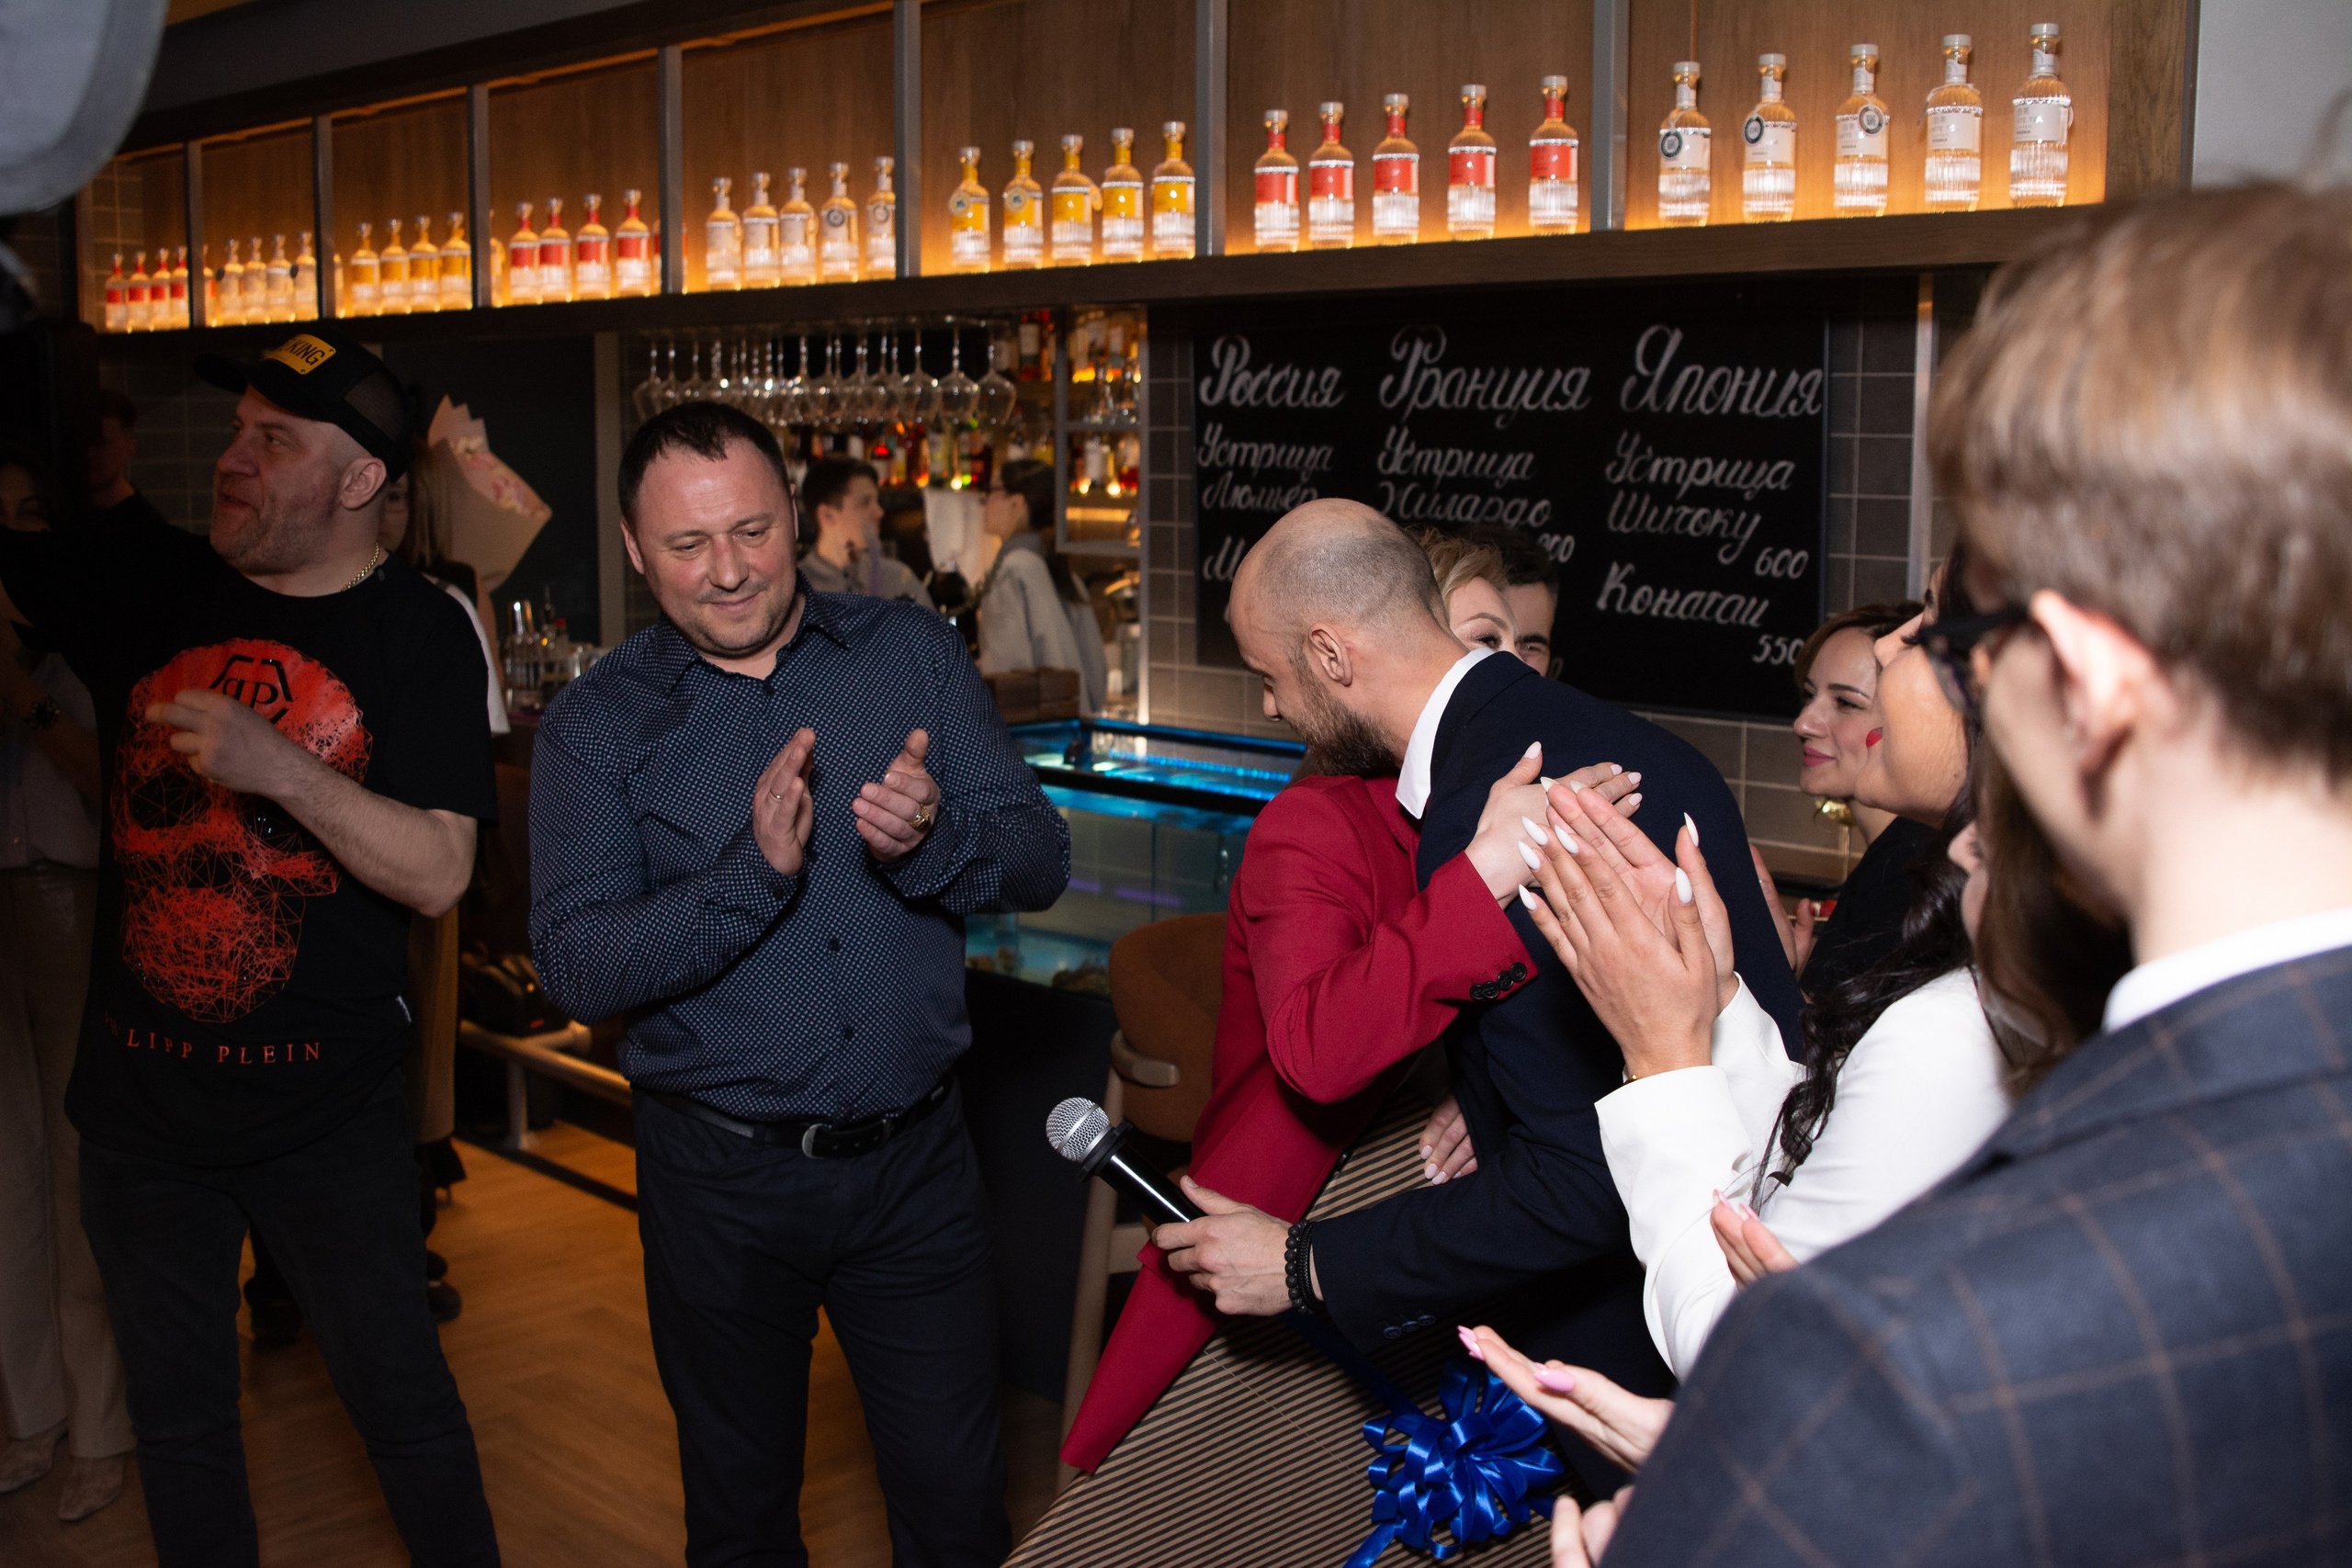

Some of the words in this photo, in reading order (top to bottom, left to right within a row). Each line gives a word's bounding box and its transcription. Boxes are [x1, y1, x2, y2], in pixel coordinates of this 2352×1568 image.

[1199, 334, 1347, 407] Россия
[1380, 325, 1591, 429] Франция
[1621, 323, 1823, 418] Япония
[1196, 421, 1333, 483] Устрица
[1378, 426, 1536, 489] Устрица
[1605, 429, 1796, 502] Устрица
[1754, 547, 1809, 579] 600
[1751, 635, 1804, 666] 550
[217, 1042, 321, 1065] PLEIN
